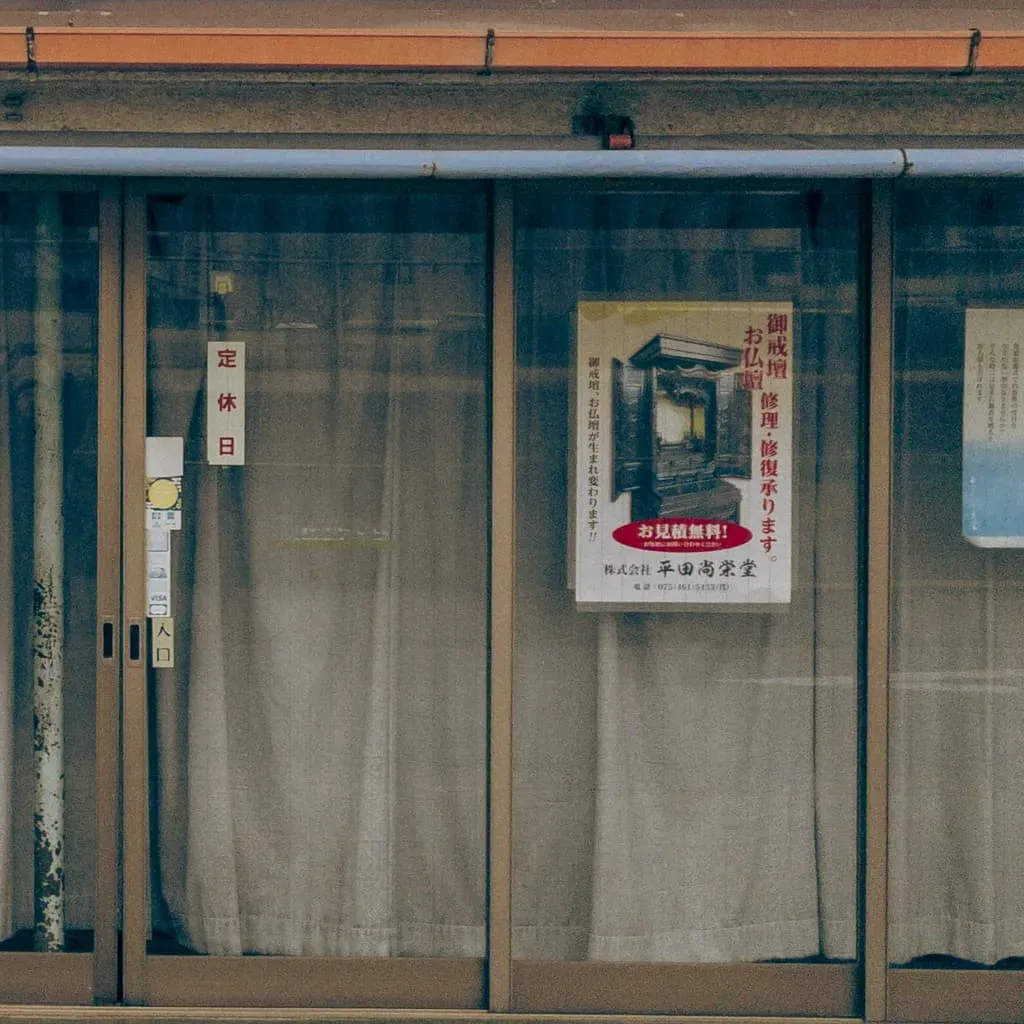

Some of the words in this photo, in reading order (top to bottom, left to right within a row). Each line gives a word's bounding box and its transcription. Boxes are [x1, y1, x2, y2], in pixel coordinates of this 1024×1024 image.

[742, 325, 764, 391] お仏壇
[767, 312, 788, 380] 御戒壇
[217, 348, 238, 456] 定休日
[604, 563, 652, 576] 株式会社
[657, 558, 758, 578] 平田尚栄堂
[157, 623, 171, 662] 入口
